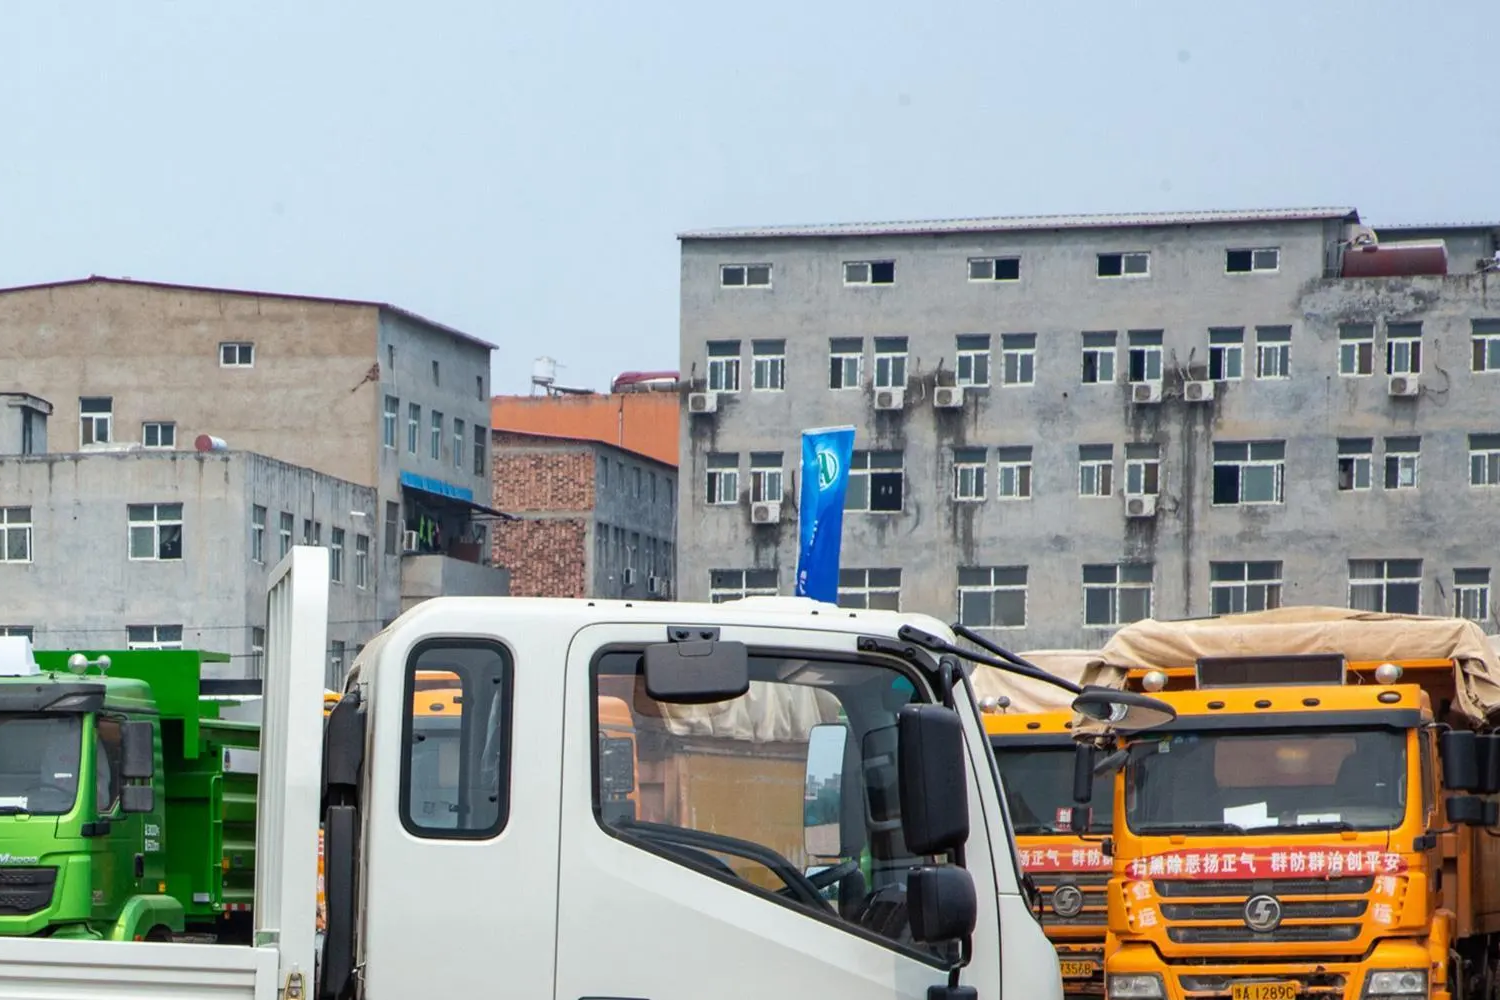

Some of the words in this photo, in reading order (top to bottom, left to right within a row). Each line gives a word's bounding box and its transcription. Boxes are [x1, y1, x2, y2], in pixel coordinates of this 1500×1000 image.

[1132, 852, 1257, 877] 扫黑除恶扬正气
[1270, 850, 1401, 873] 群防群治创平安
